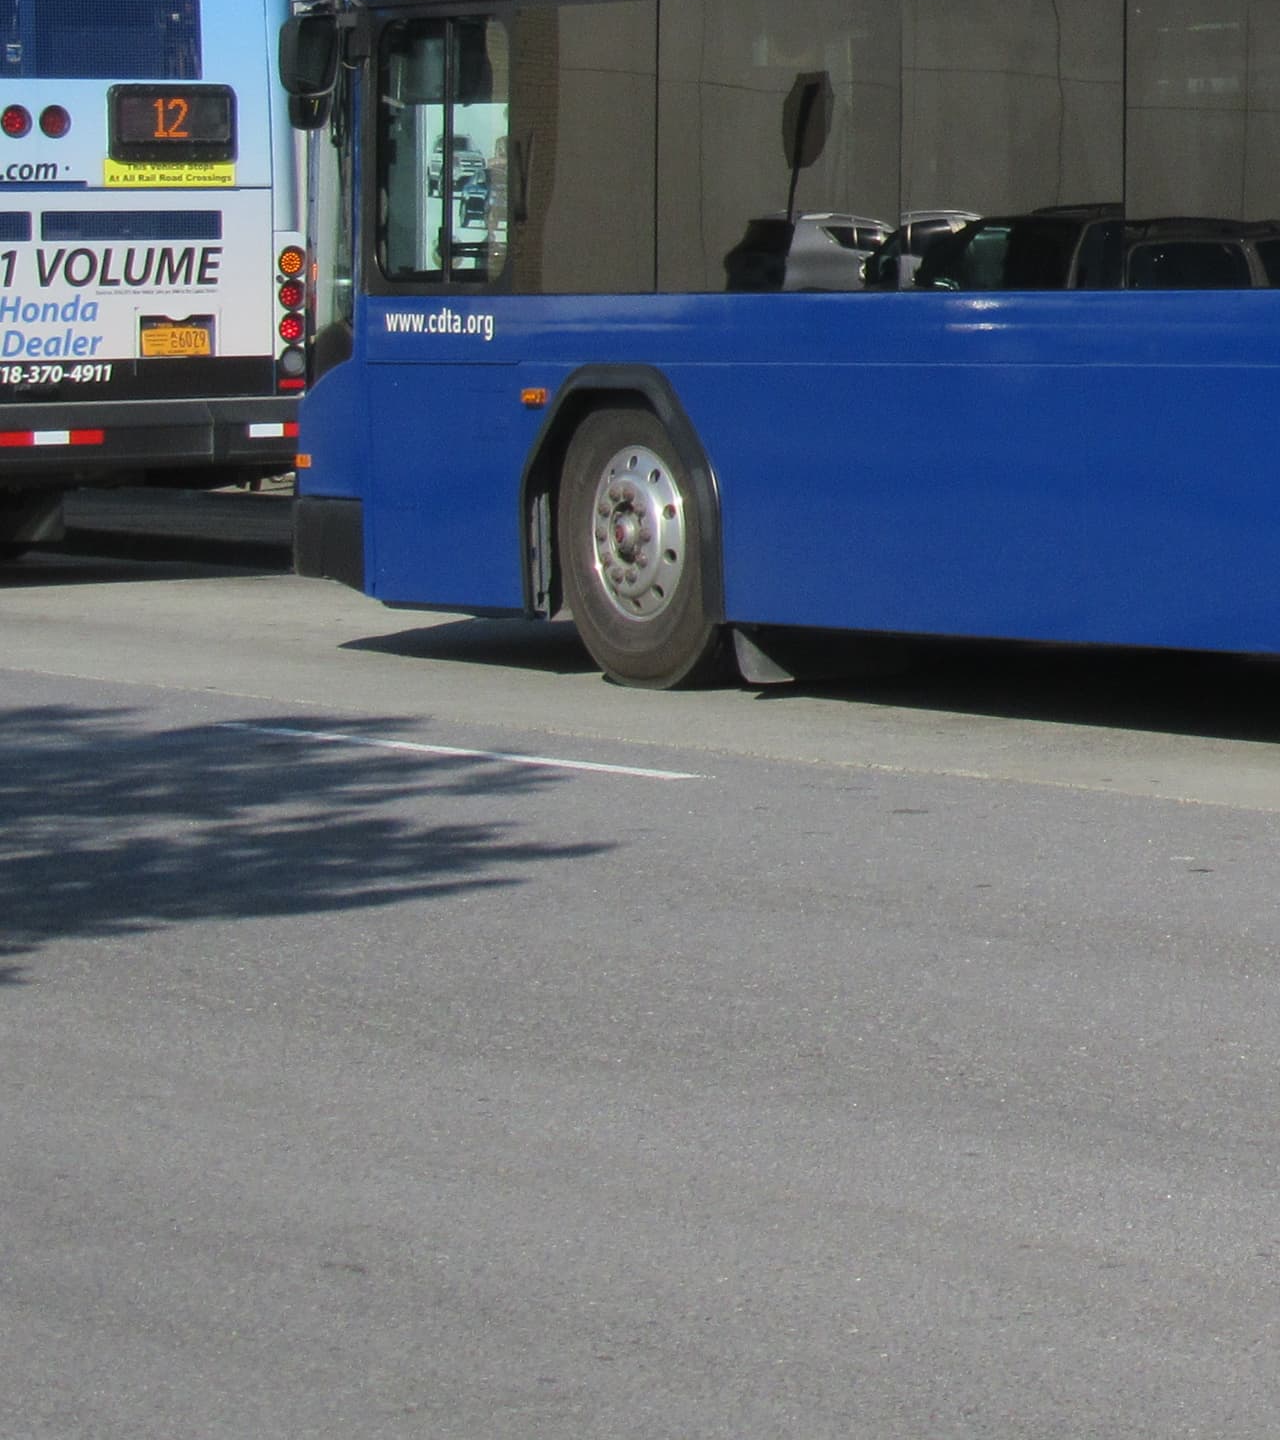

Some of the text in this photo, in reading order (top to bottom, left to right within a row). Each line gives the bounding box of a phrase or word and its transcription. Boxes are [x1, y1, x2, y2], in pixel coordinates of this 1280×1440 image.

[152, 97, 189, 138] 12
[109, 173, 231, 183] At All Rail Road Crossings
[36, 247, 224, 288] VOLUME
[0, 294, 99, 324] Honda
[385, 307, 494, 341] www.cdta.org
[2, 328, 104, 358] Dealer
[0, 364, 113, 385] 18-370-4911
